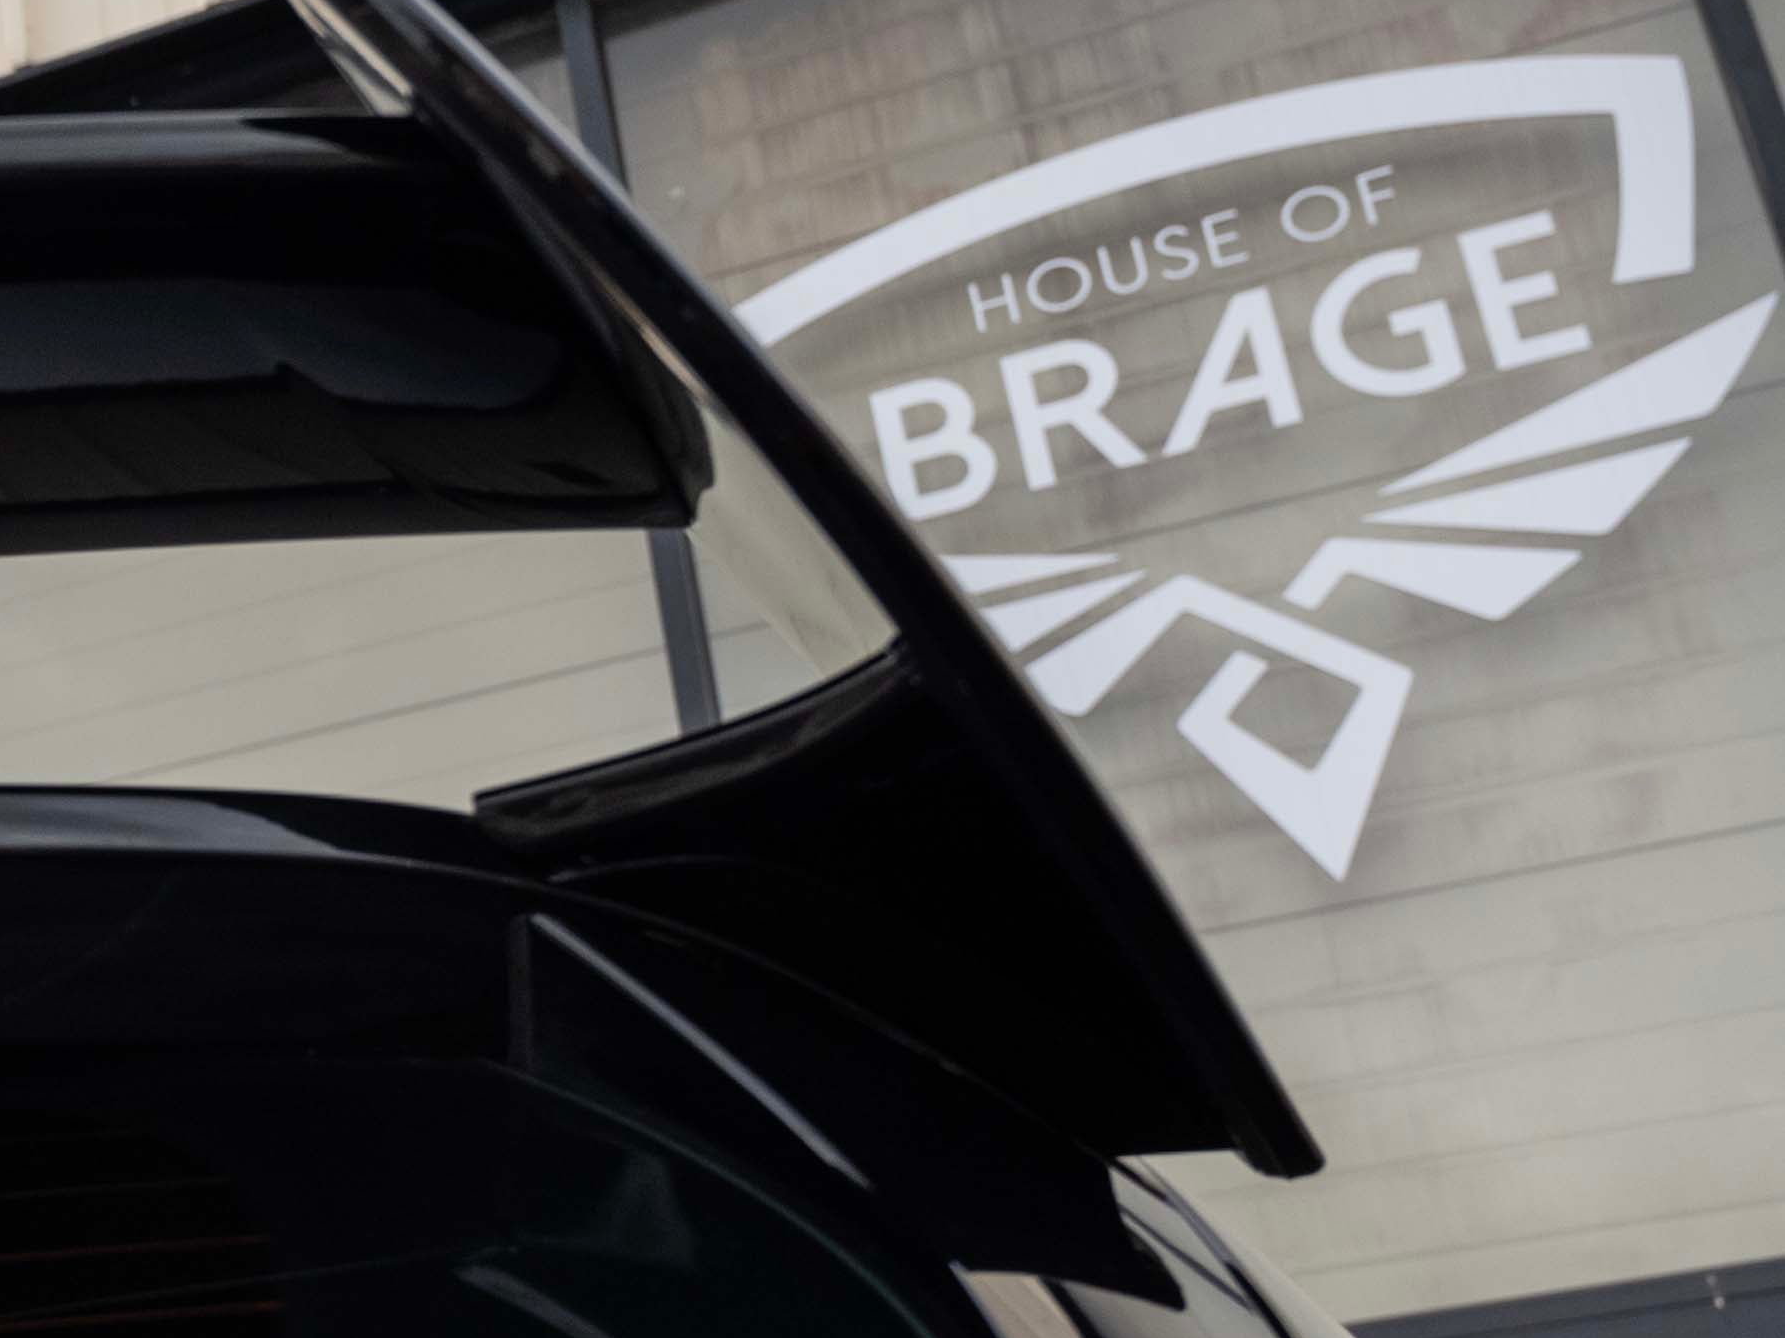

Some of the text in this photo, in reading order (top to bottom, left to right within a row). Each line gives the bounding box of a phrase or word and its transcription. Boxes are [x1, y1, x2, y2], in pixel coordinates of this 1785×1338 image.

[869, 210, 1592, 521] BRAGE
[968, 166, 1398, 332] HOUSE OF
